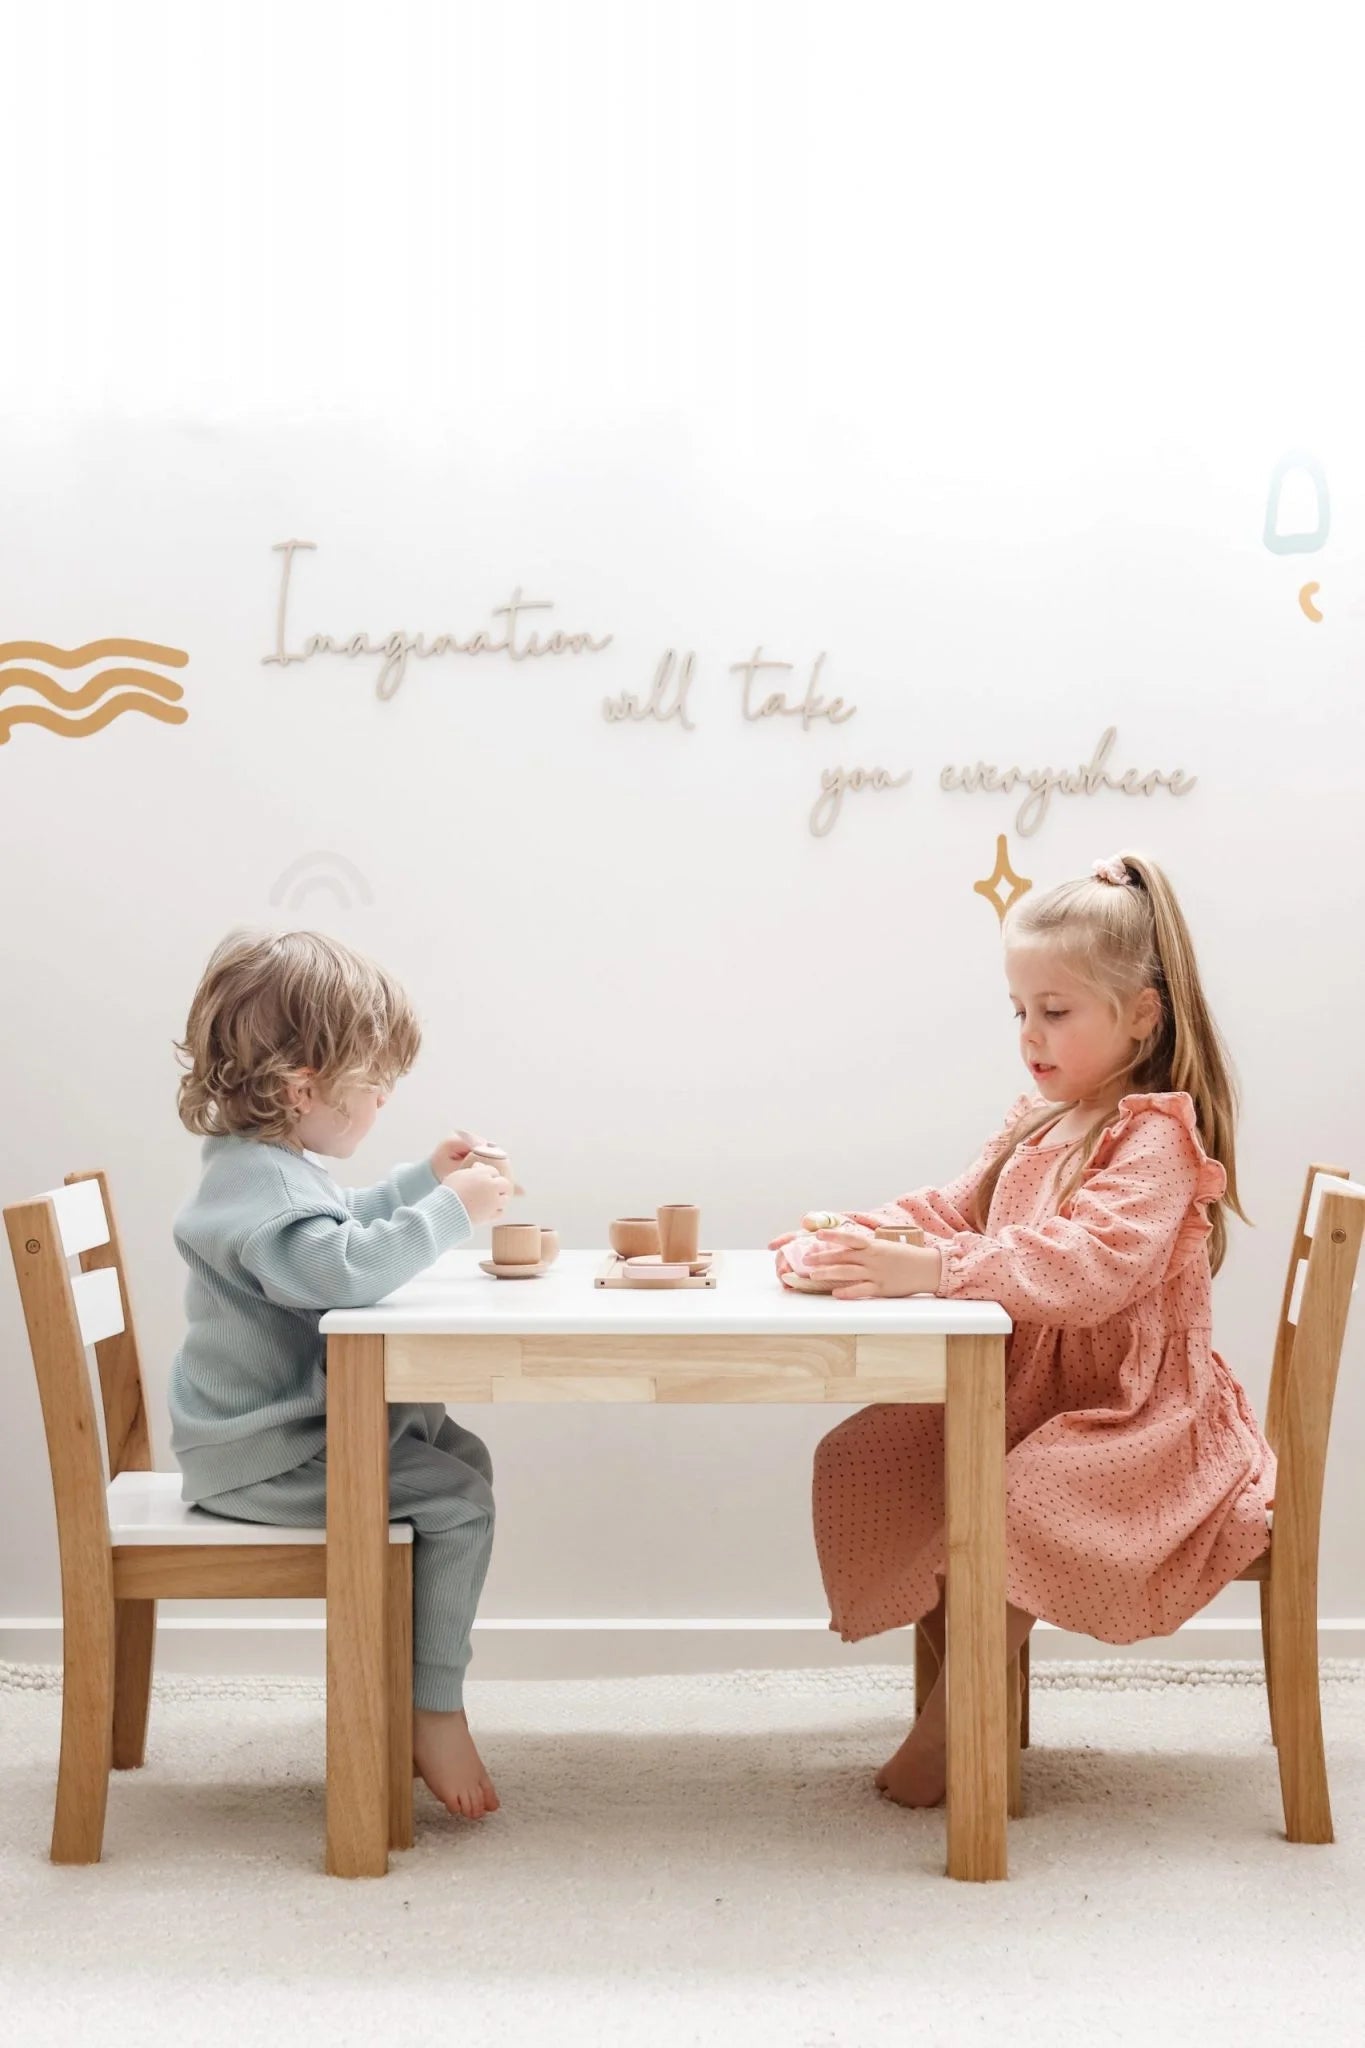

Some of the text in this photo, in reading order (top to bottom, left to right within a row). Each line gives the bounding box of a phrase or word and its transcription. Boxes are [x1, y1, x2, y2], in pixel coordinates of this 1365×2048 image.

[261, 539, 614, 701] Imagination
[602, 645, 857, 731] will take
[809, 725, 1198, 838] you everywhere
